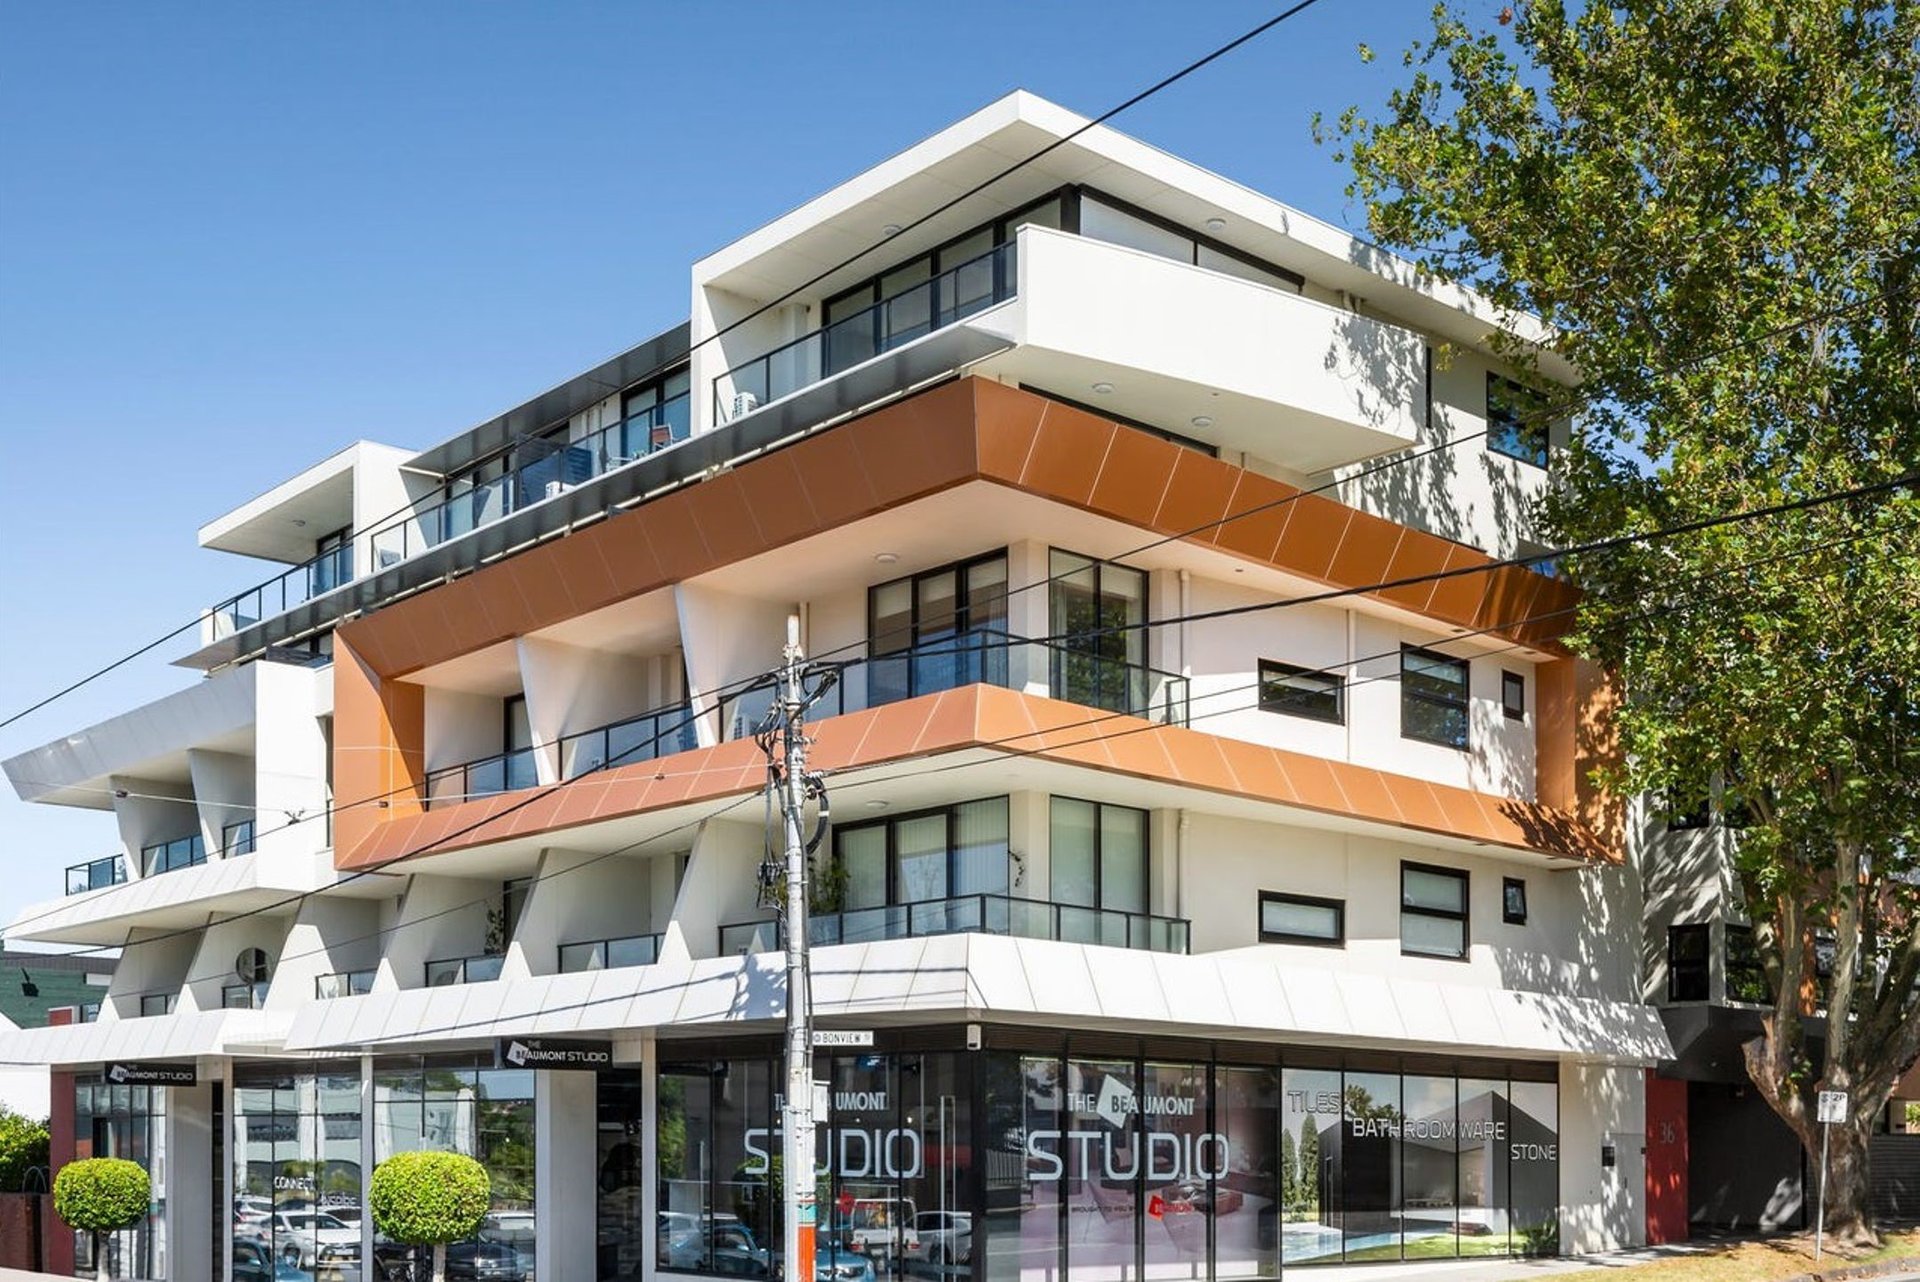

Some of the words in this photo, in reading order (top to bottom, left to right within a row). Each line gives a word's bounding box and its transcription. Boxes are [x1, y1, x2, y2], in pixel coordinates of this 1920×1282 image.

[822, 1032, 861, 1044] BONVIEW
[567, 1051, 609, 1062] STUDIO
[159, 1072, 194, 1081] STUDIO
[1067, 1092, 1096, 1113] THE
[1111, 1095, 1195, 1116] BEAUMONT
[1287, 1090, 1341, 1115] TILES
[1660, 1121, 1675, 1144] 36
[744, 1128, 921, 1179] SUDIO
[1027, 1130, 1229, 1181] STUDIO
[1510, 1143, 1557, 1161] STONE
[274, 1176, 316, 1191] CONNECT
